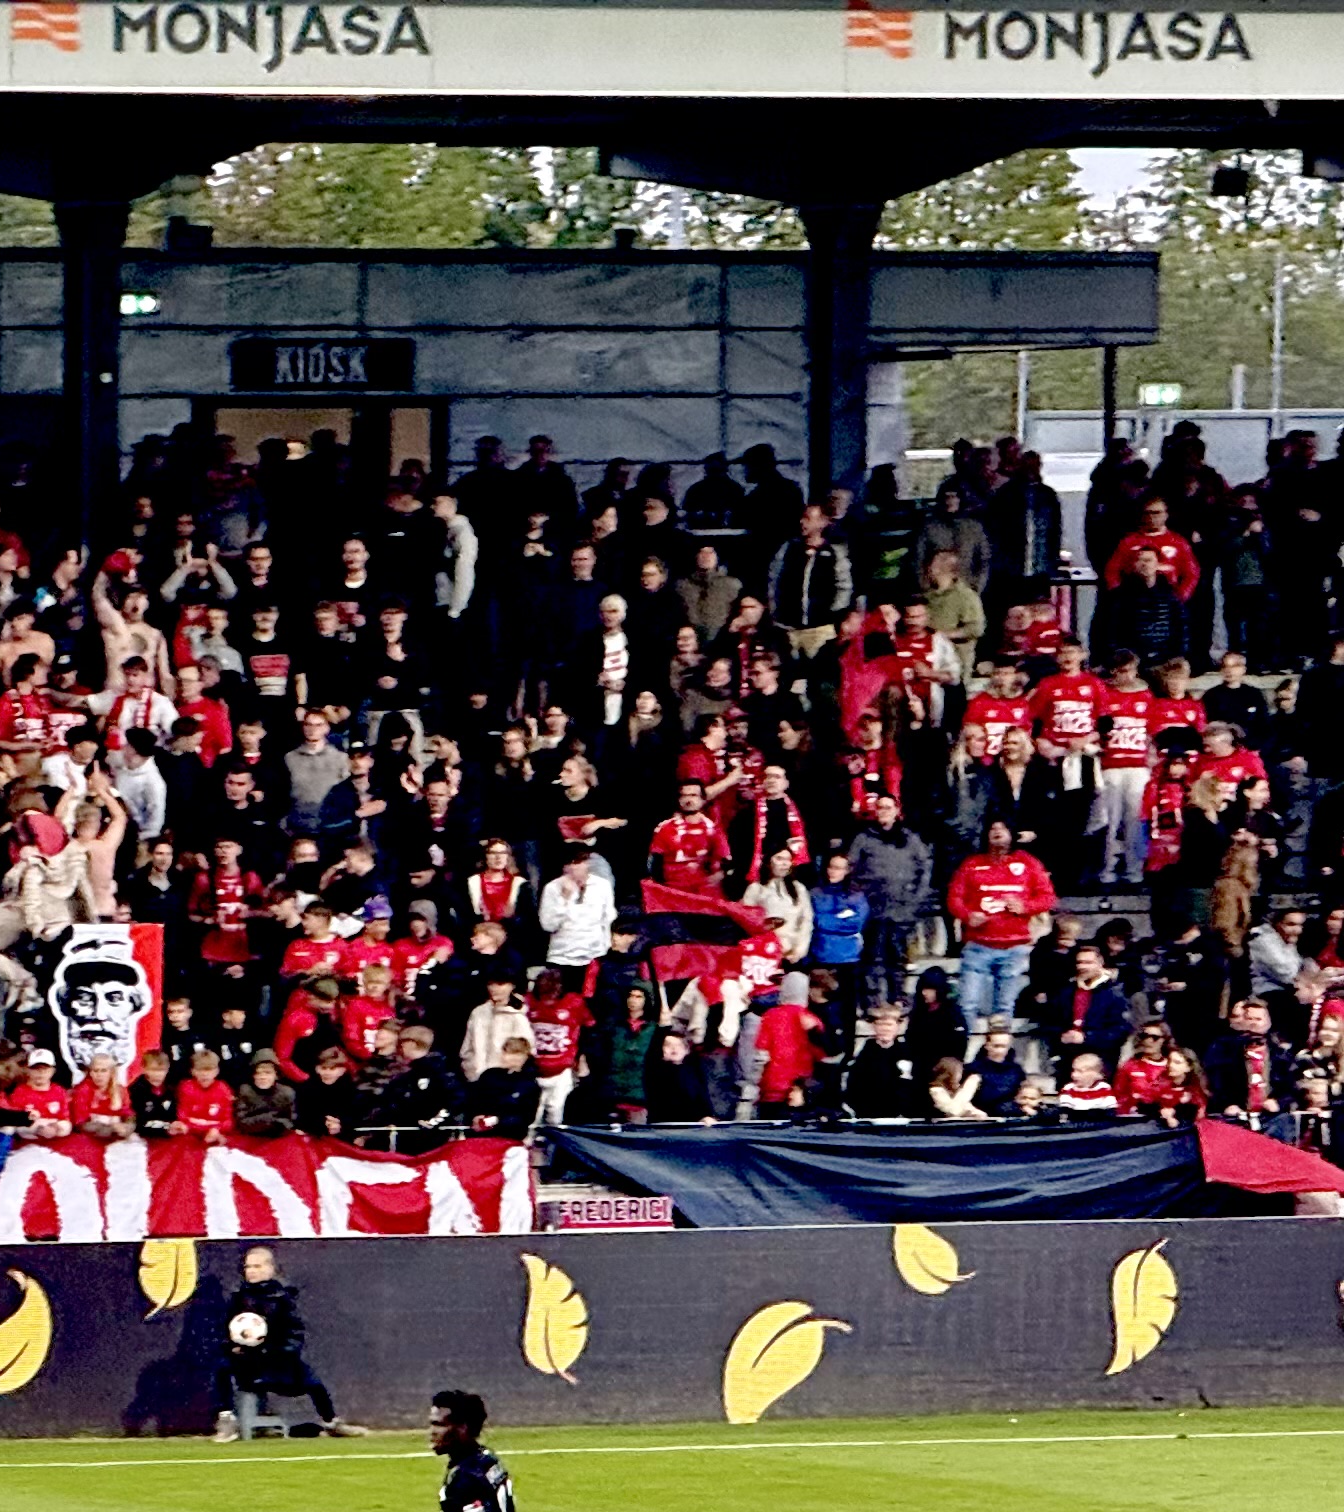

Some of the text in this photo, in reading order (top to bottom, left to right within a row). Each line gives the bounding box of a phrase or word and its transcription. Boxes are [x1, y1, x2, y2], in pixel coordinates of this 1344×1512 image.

[113, 3, 430, 74] MONJASA
[944, 11, 1253, 79] MONJASA
[274, 343, 369, 384] KIOSK
